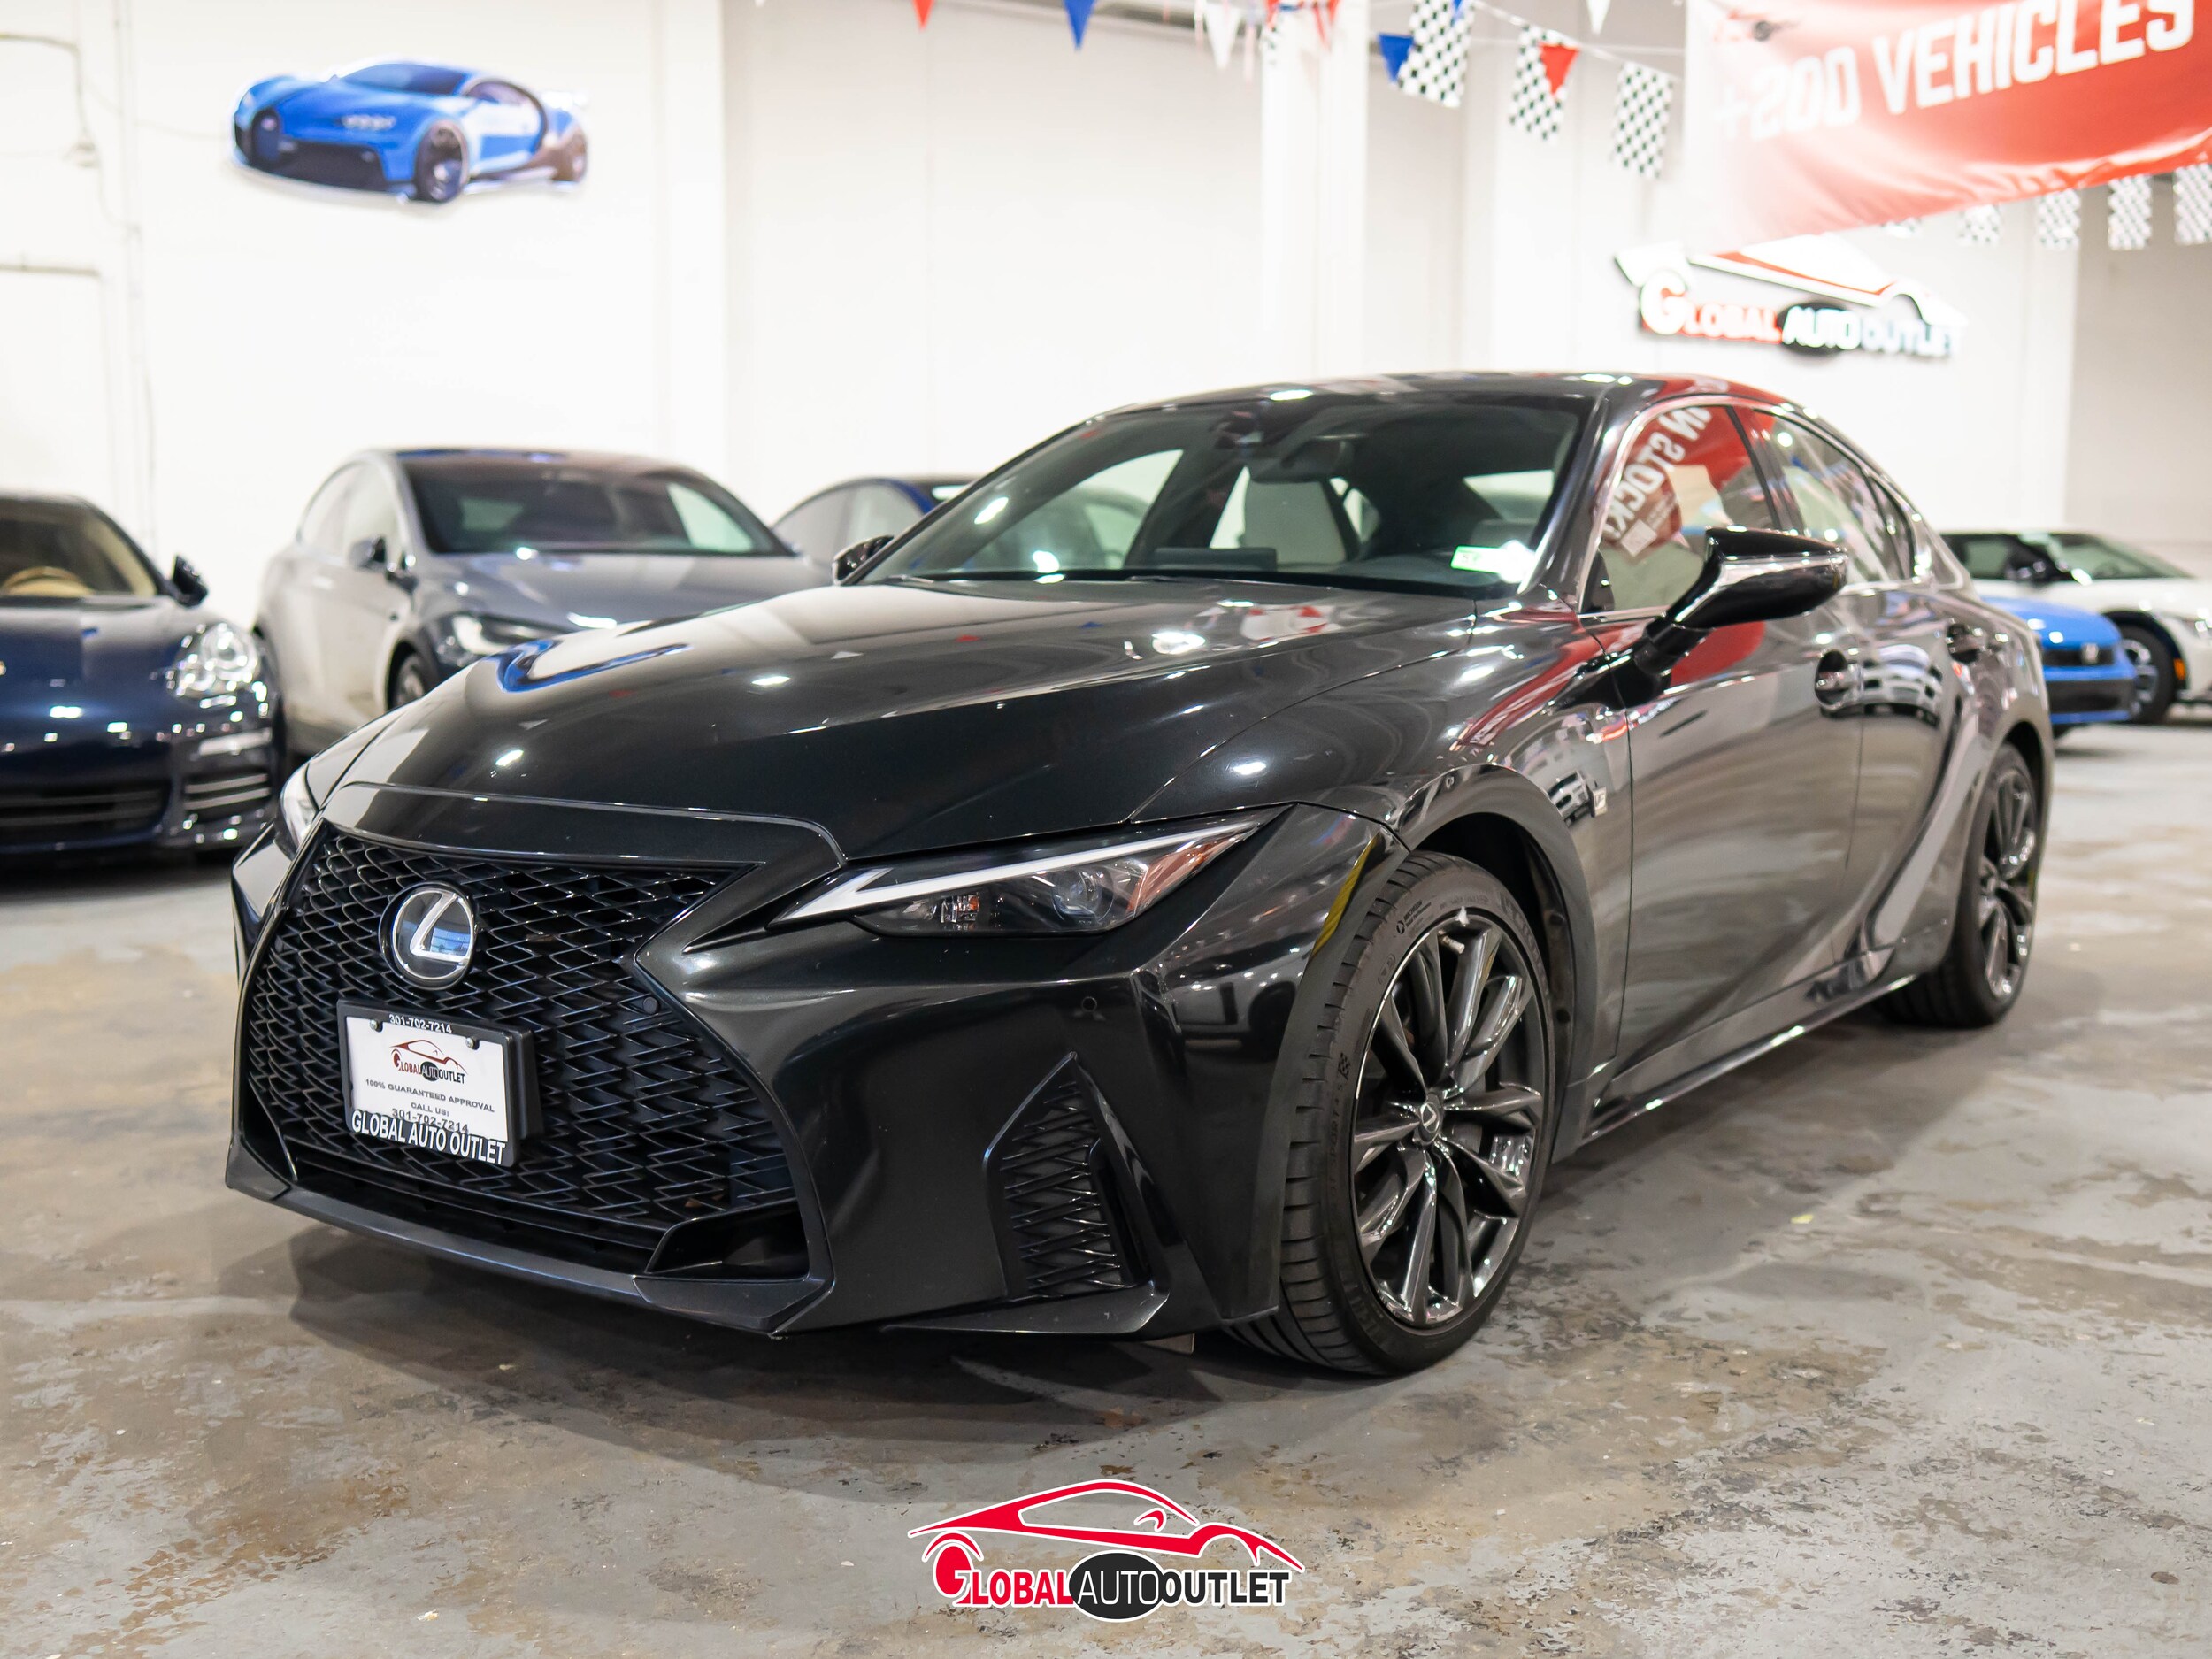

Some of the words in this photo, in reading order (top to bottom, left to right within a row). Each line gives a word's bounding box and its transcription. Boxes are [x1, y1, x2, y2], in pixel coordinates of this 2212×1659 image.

[1871, 0, 2196, 116] VEHICLES
[1639, 268, 1782, 344] GLOBAL
[388, 1014, 452, 1034] 301-702-7214
[439, 1071, 465, 1085] OUTLET
[365, 1079, 386, 1090] 100%
[388, 1083, 446, 1102] GUARANTEED
[449, 1095, 495, 1113] APPROVAL
[411, 1102, 433, 1113] CALL
[392, 1108, 469, 1133] 301-702-7214
[351, 1110, 406, 1143] GLOBAL
[408, 1122, 447, 1152] AUTO
[449, 1132, 506, 1165] OUTLET
